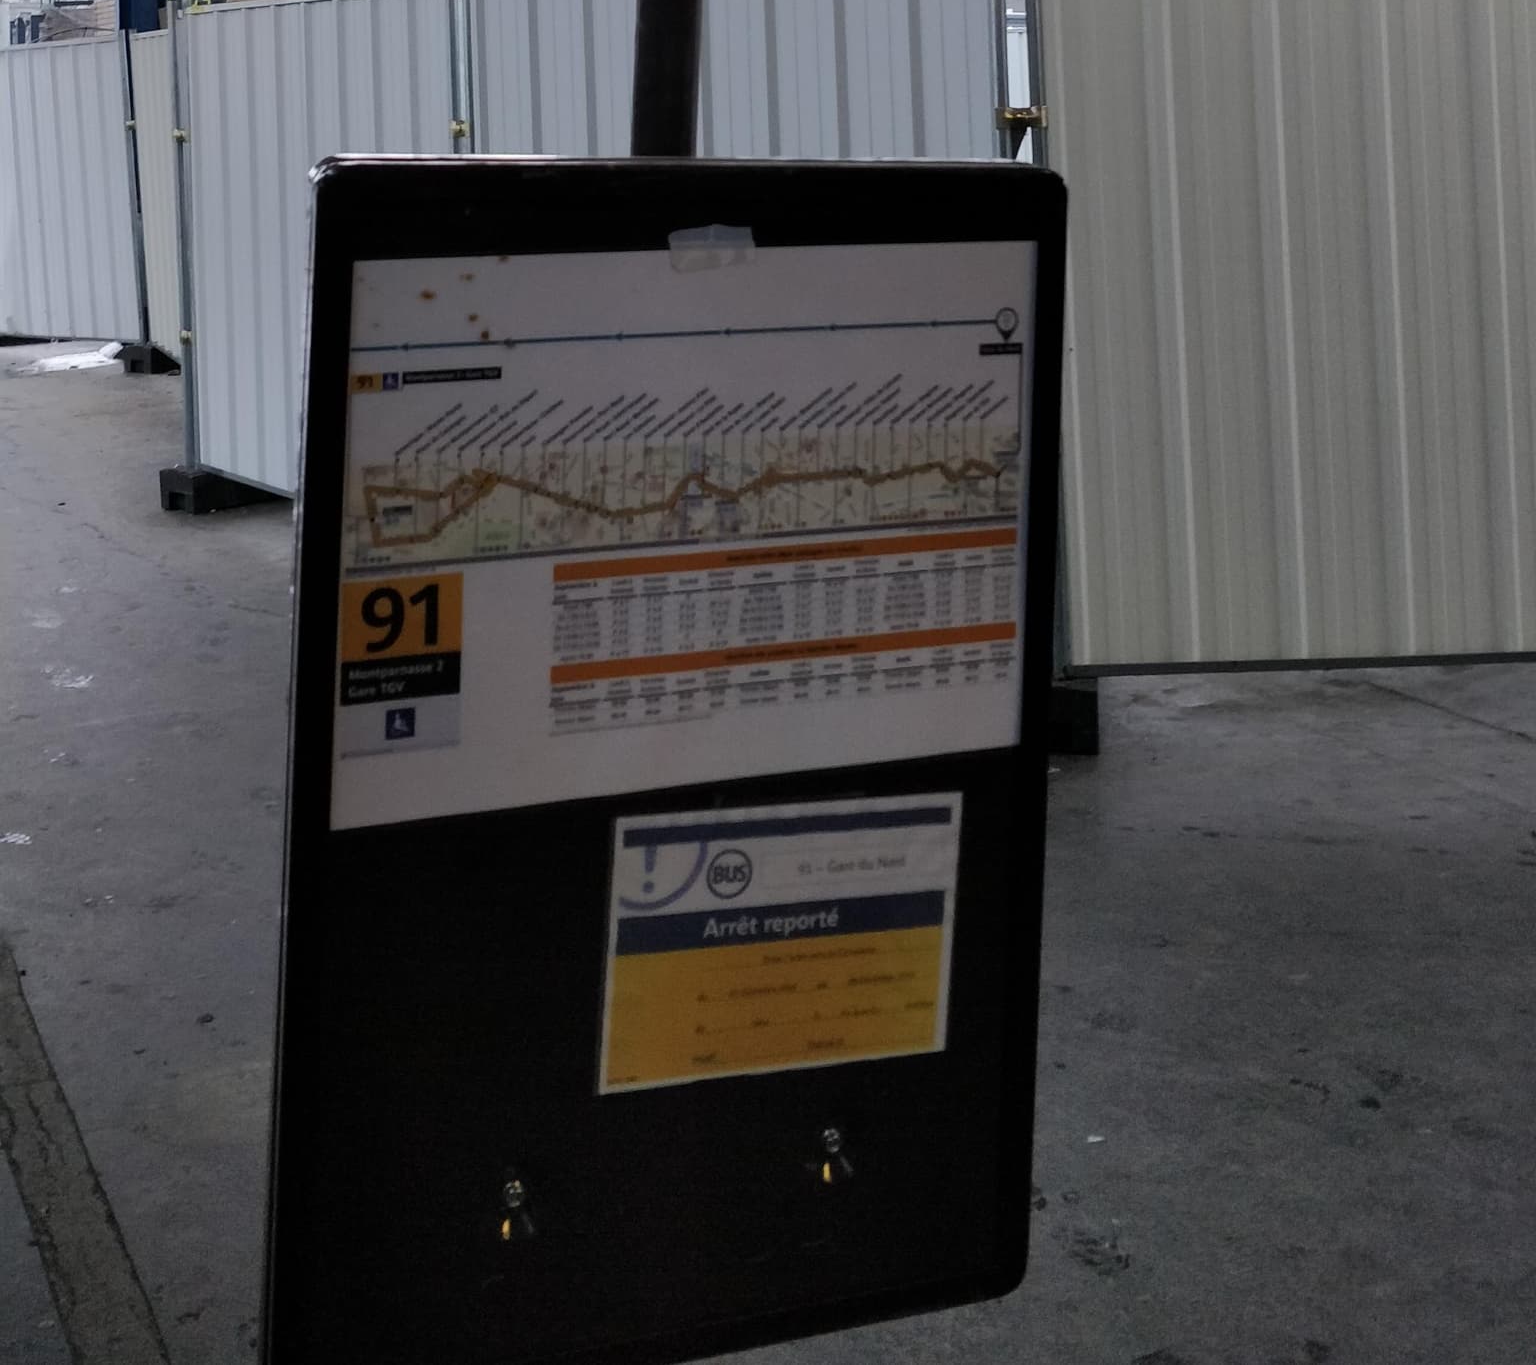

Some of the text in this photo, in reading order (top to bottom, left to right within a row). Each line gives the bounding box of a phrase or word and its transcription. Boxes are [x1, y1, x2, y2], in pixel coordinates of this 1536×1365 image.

[360, 583, 440, 654] 91
[348, 659, 445, 680] Montparnasse 2
[347, 681, 407, 698] Gare TGV
[713, 861, 747, 884] BUS
[827, 857, 856, 874] Gare
[877, 853, 907, 868] Nord
[703, 906, 840, 939] Arrêt reporté
